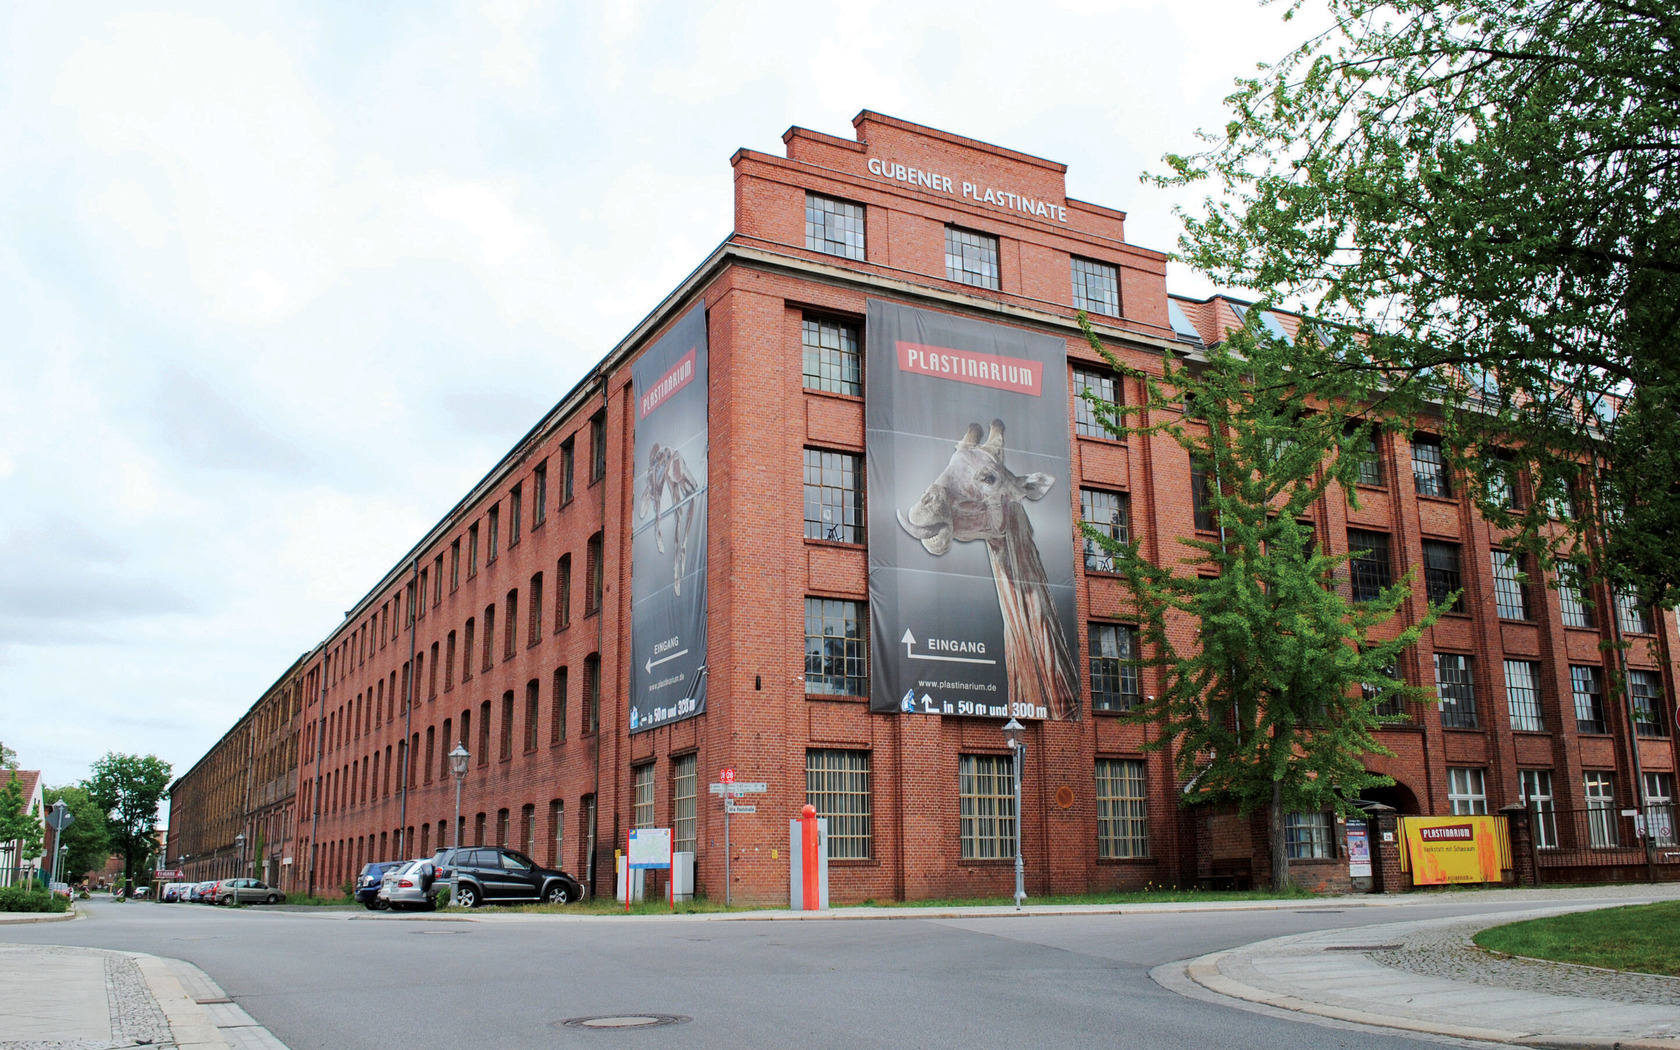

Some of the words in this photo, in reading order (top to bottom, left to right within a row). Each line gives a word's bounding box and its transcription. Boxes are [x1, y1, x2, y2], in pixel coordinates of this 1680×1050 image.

[867, 158, 954, 194] GUBENER
[962, 181, 1067, 222] PLASTINATE
[908, 349, 1033, 386] PLASTINARIUM
[643, 360, 691, 414] PLASTINARIUM
[654, 636, 679, 655] EINGANG
[928, 638, 985, 653] EINGANG
[918, 679, 997, 692] www.plastinarium.de
[943, 700, 954, 714] in
[958, 700, 974, 714] 50
[975, 703, 987, 716] m
[989, 703, 1008, 717] und
[1011, 702, 1034, 718] 300
[1036, 706, 1047, 718] m
[1423, 828, 1470, 838] PLASTINARIUM
